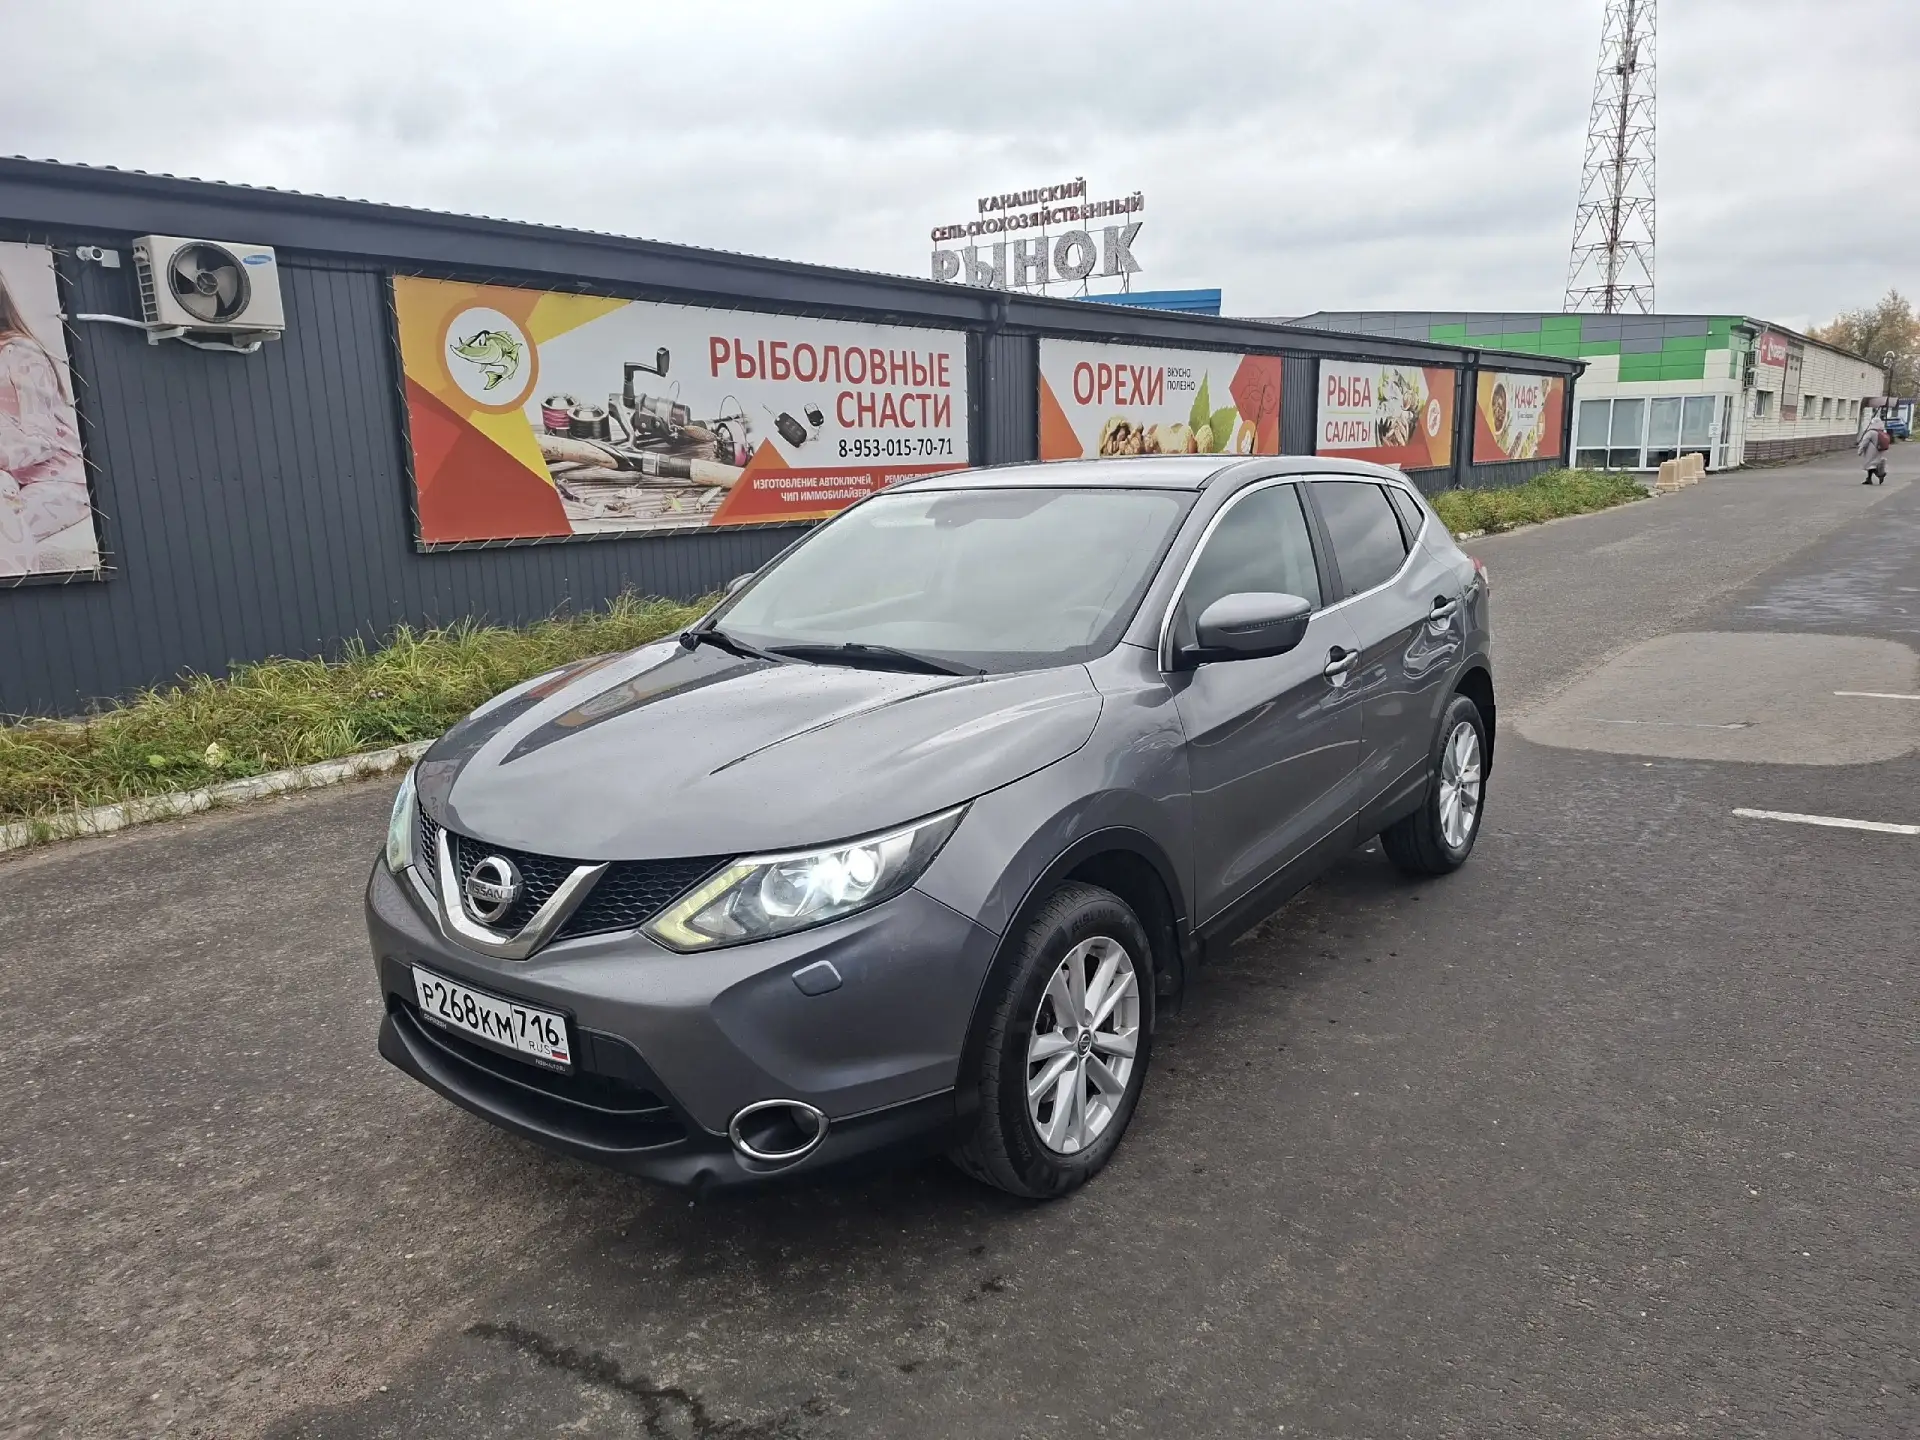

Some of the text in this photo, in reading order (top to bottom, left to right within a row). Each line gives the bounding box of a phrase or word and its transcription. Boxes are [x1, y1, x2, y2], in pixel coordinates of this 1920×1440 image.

[977, 176, 1086, 213] КАНАШСКИЙ
[930, 190, 1145, 242] СЕЛЬСКОХОЗЯЙСТВЕННЫЙ
[931, 221, 1143, 288] РЫНОК
[709, 336, 951, 388] РЫБОЛОВНЫЕ
[1073, 361, 1164, 406] ОРЕХИ
[1327, 374, 1372, 407] РЫБА
[1514, 385, 1538, 409] КАФЕ
[836, 391, 951, 428] СНАСТИ
[838, 438, 953, 458] 8-953-015-70-71
[1325, 420, 1371, 443] САЛАТЫ
[753, 476, 818, 490] ИЗГОТОВЛЕНИЕ
[818, 474, 874, 487] АВТОКЛЮЧЕЙ,
[780, 492, 800, 502] ЧИП
[528, 1040, 552, 1055] RUS
